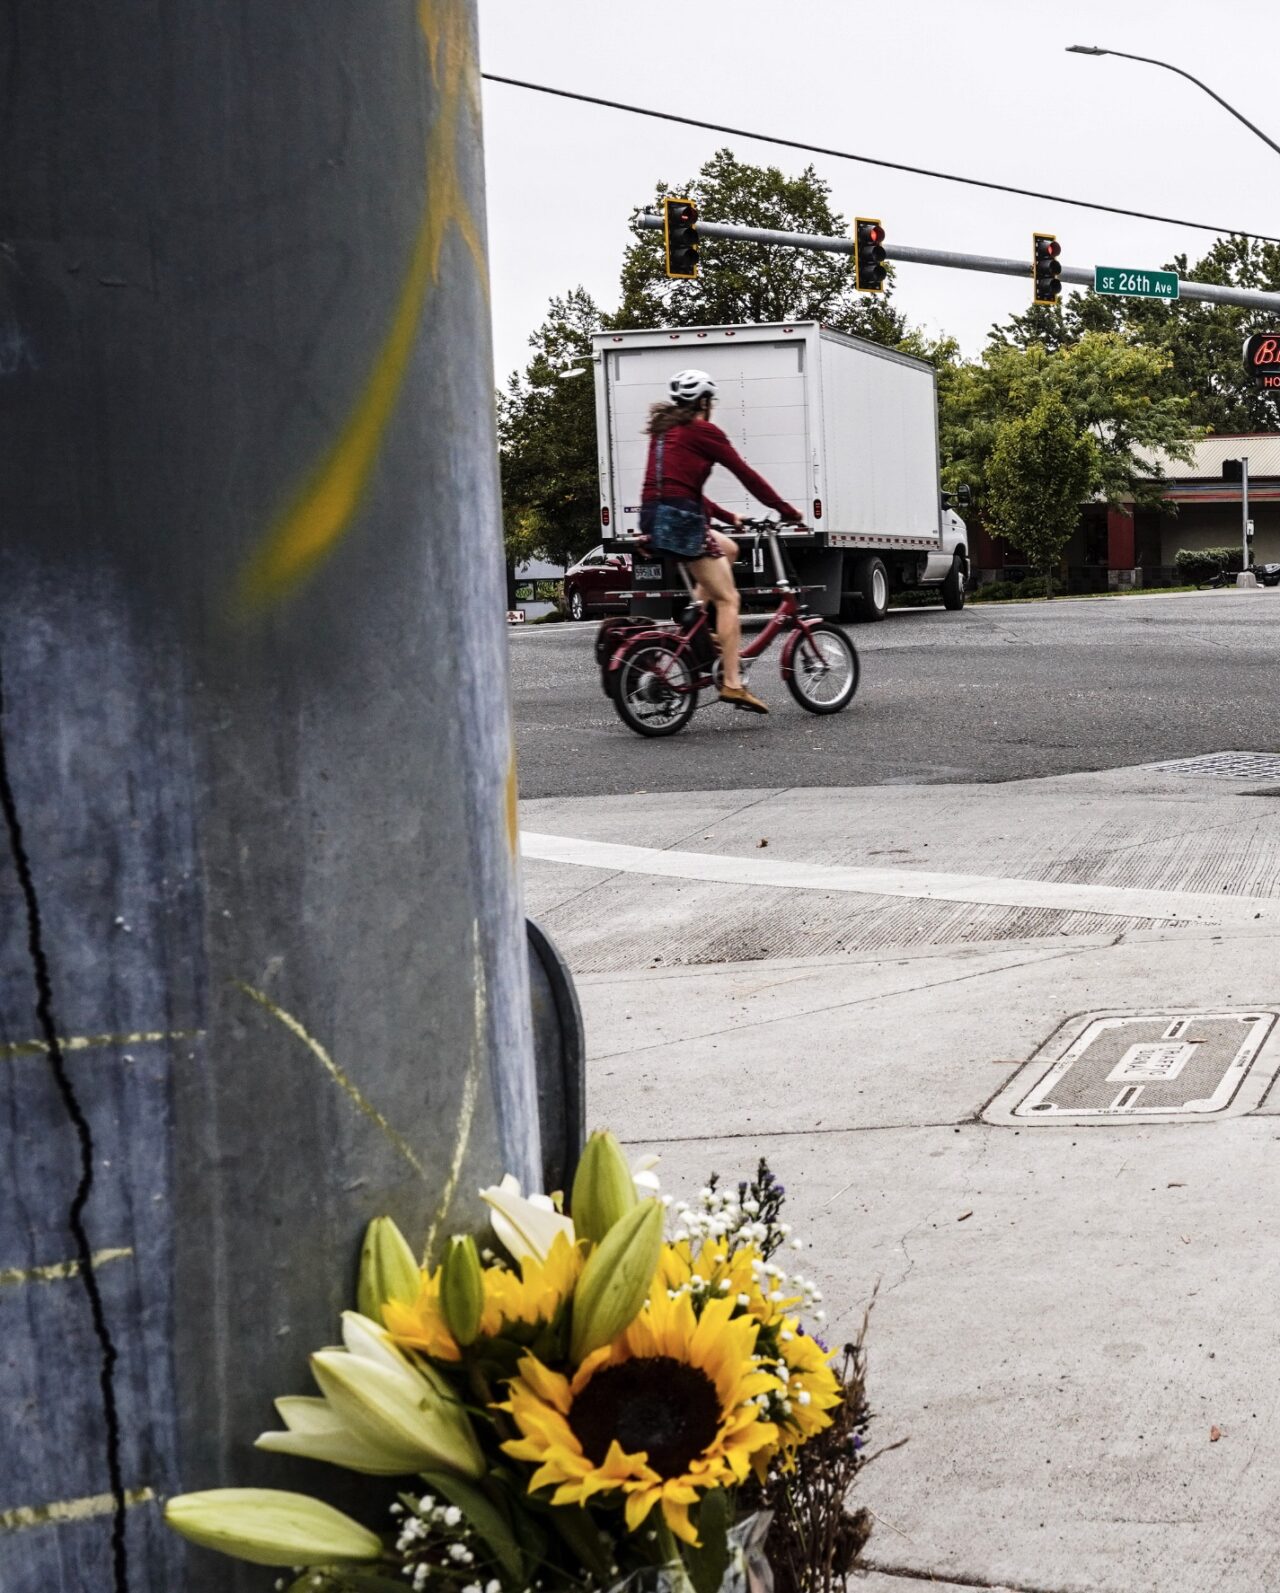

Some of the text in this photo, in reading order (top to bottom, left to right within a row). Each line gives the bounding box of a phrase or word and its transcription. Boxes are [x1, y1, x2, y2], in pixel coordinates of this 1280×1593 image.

[1102, 272, 1172, 294] SE 26th Ave
